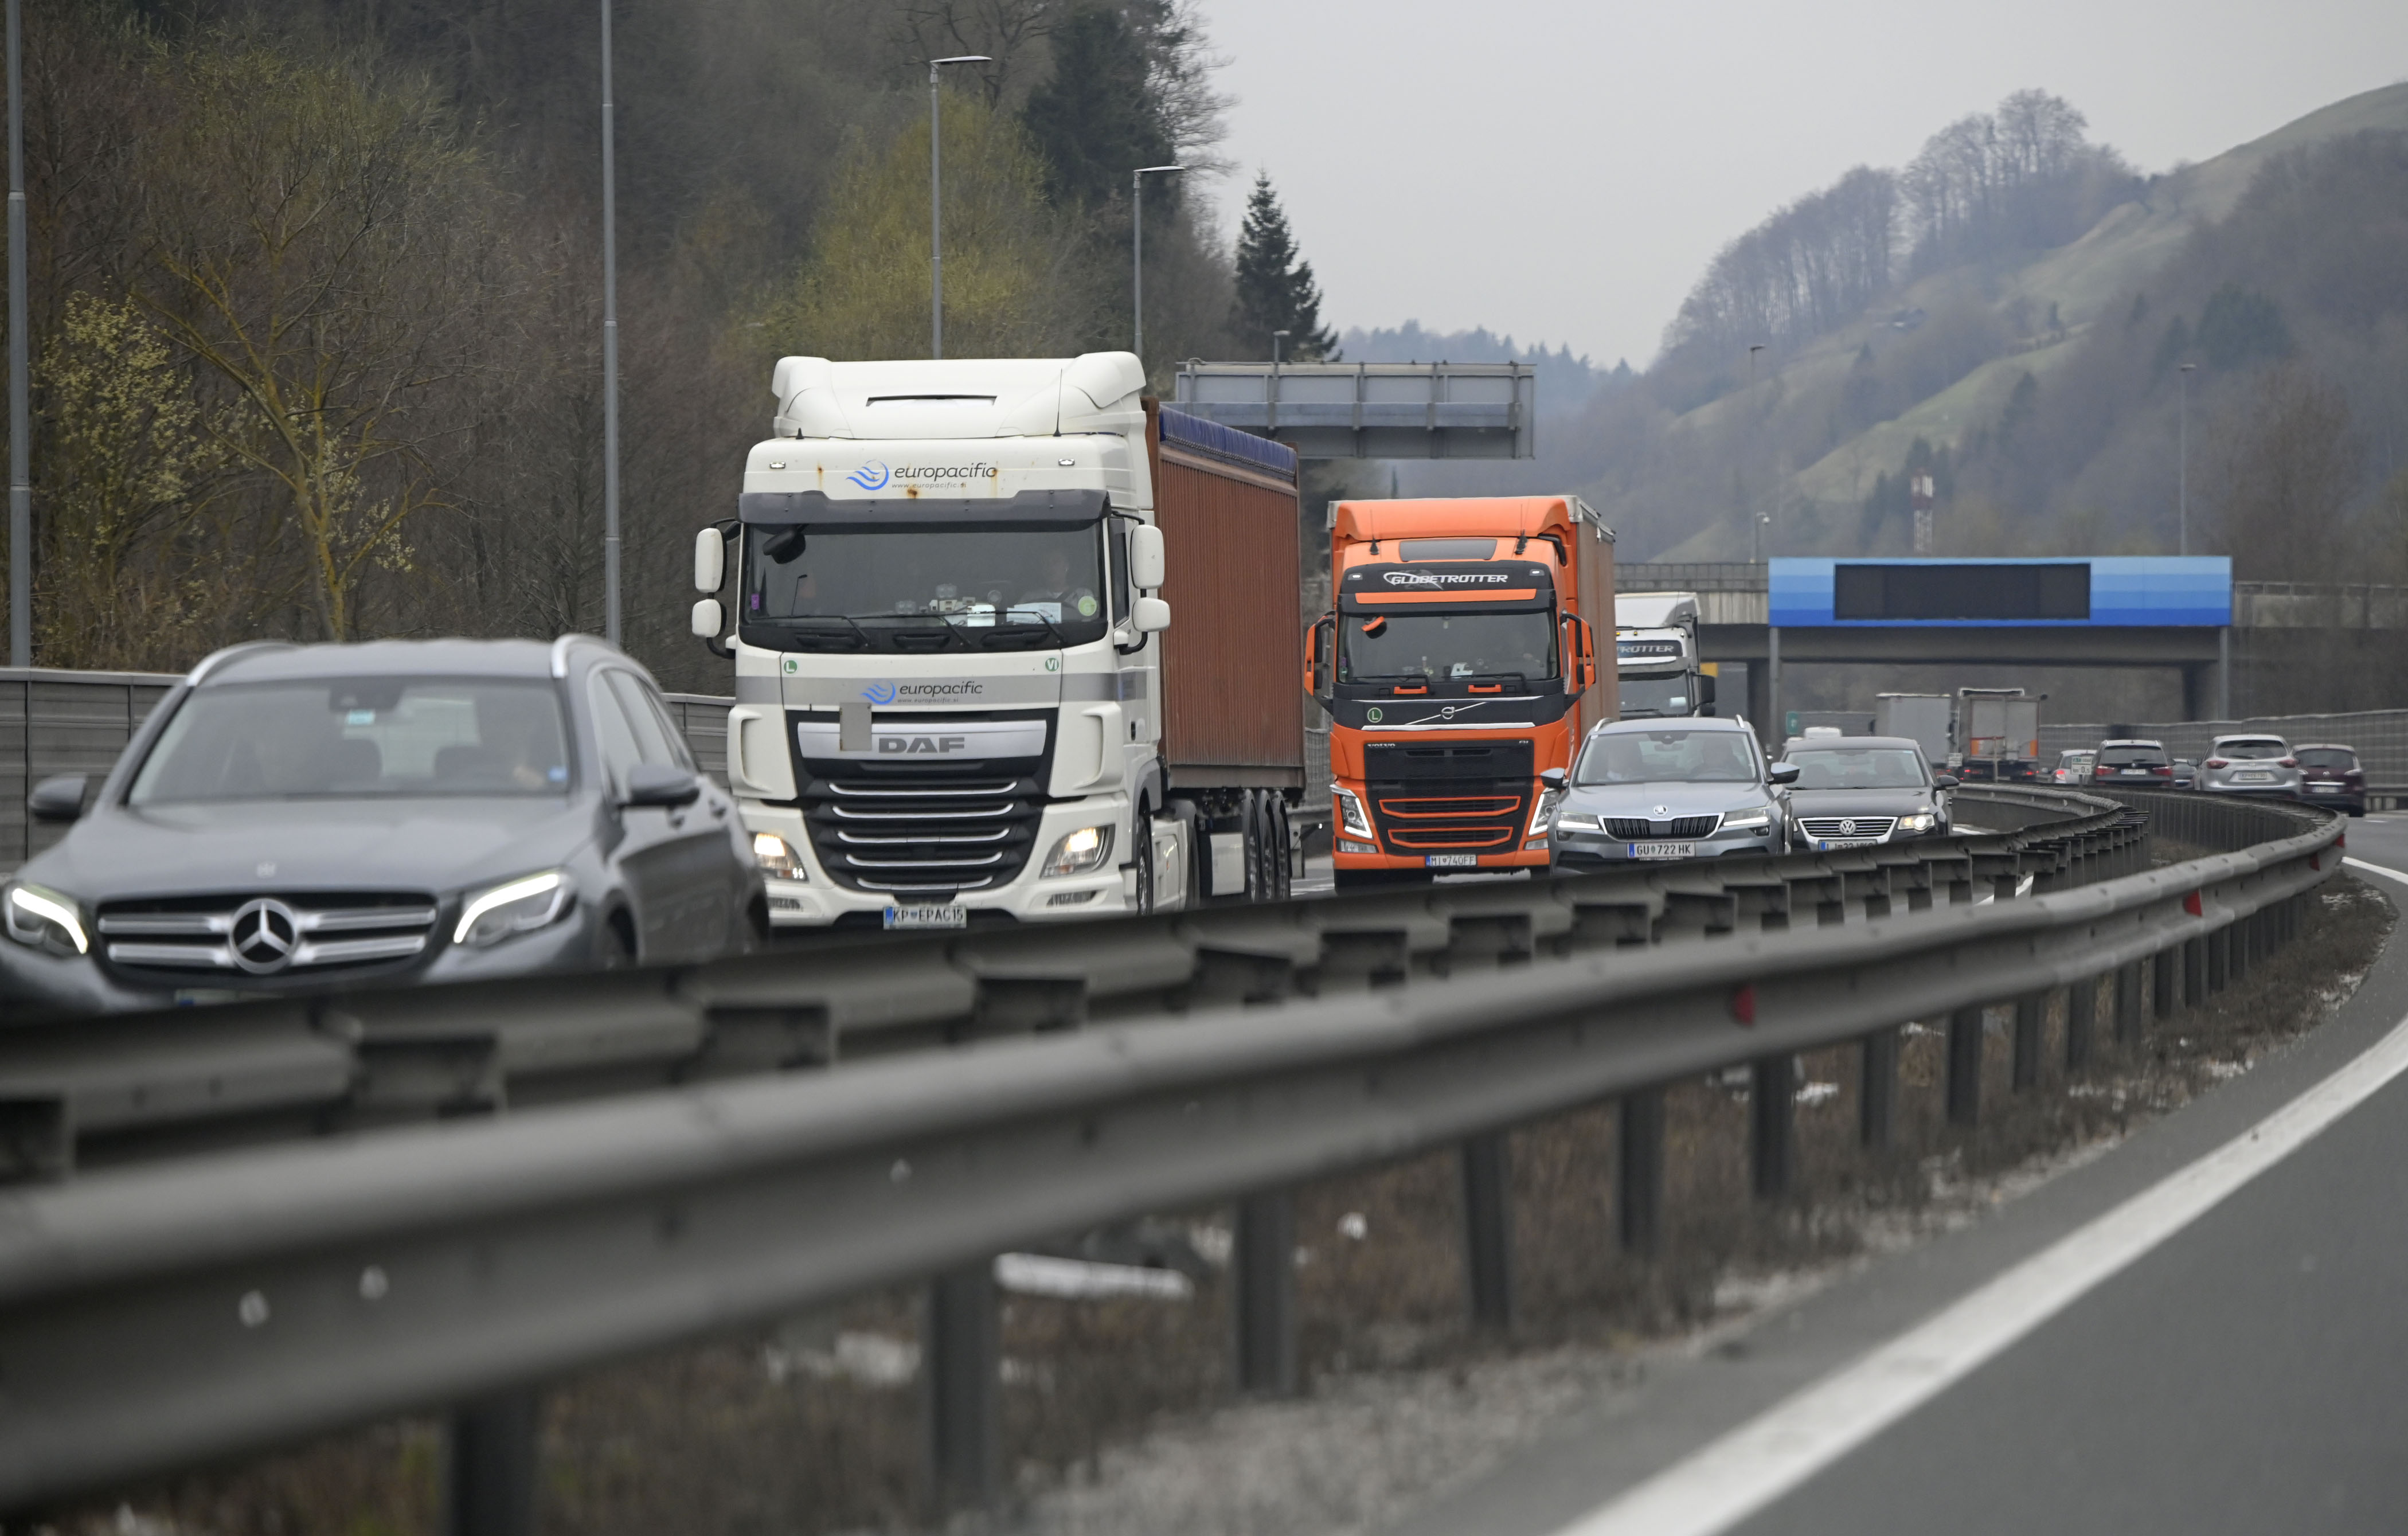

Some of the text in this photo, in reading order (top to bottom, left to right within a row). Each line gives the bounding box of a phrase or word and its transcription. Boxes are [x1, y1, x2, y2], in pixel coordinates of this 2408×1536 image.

[894, 463, 996, 481] europacific
[1390, 574, 1508, 584] GLOBETROTTER
[786, 662, 795, 672] L
[1047, 659, 1057, 670] VI
[900, 681, 983, 697] europacific
[1372, 710, 1378, 720] L
[879, 737, 964, 753] DAF
[1637, 844, 1691, 855] GU 722 HK
[893, 908, 963, 922] KP EPAC15
